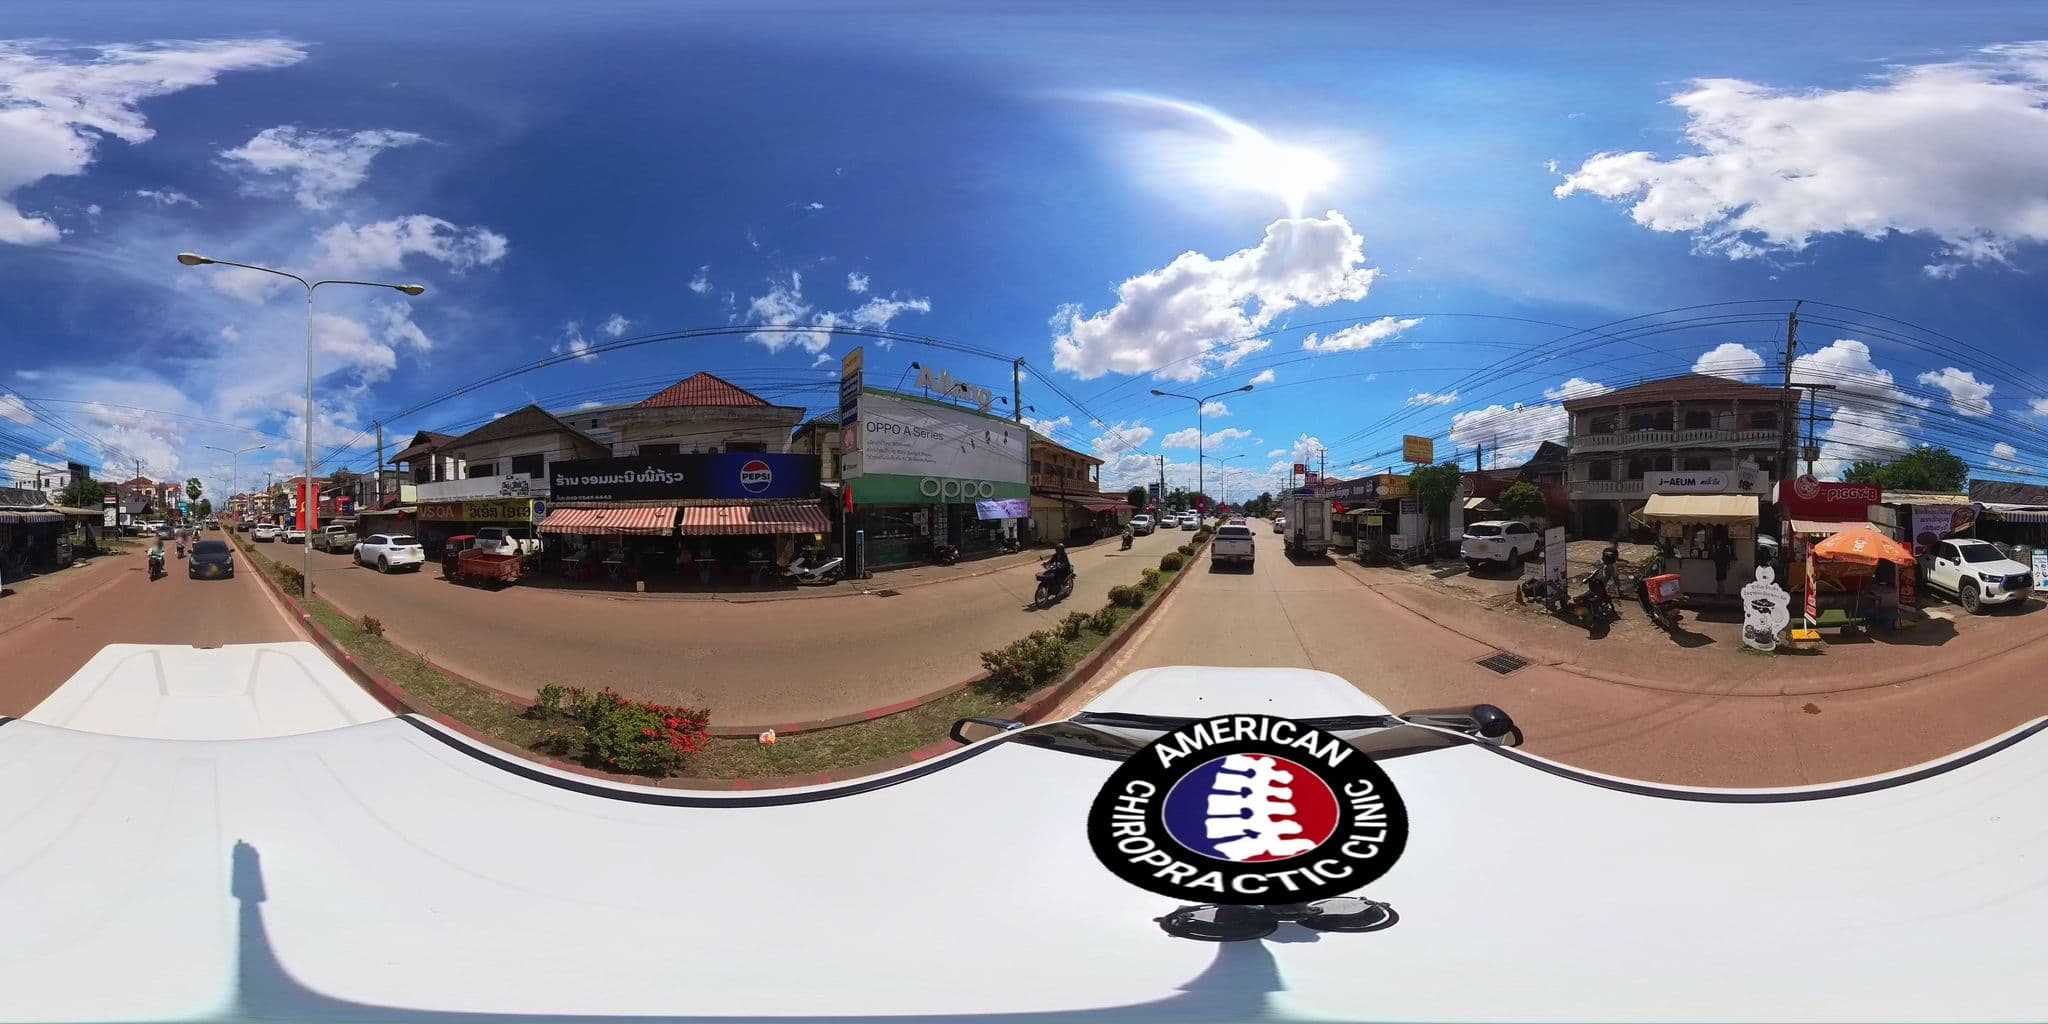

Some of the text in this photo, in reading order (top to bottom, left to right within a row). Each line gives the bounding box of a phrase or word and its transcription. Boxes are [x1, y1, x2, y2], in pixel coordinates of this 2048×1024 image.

[866, 421, 944, 441] OPPO A Series
[742, 472, 770, 481] PEPSI
[1658, 477, 1697, 487] J-AEUM
